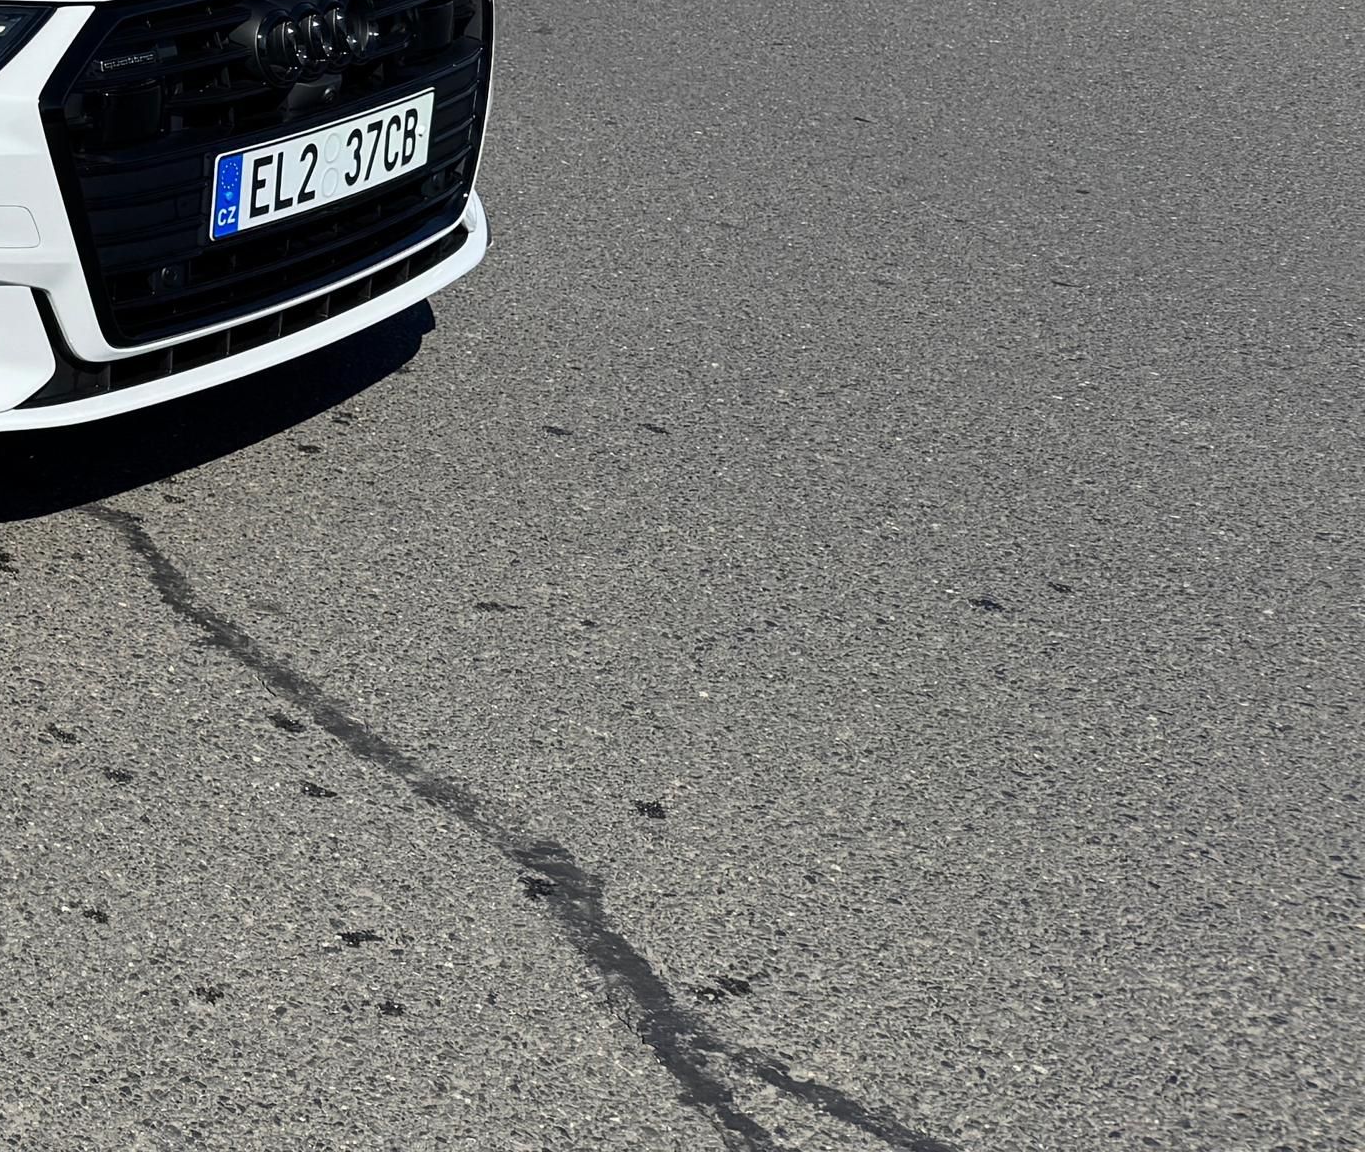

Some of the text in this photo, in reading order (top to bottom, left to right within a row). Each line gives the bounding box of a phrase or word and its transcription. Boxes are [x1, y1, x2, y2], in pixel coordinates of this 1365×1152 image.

[249, 108, 418, 219] EL2 37CB
[218, 206, 236, 226] CZ
